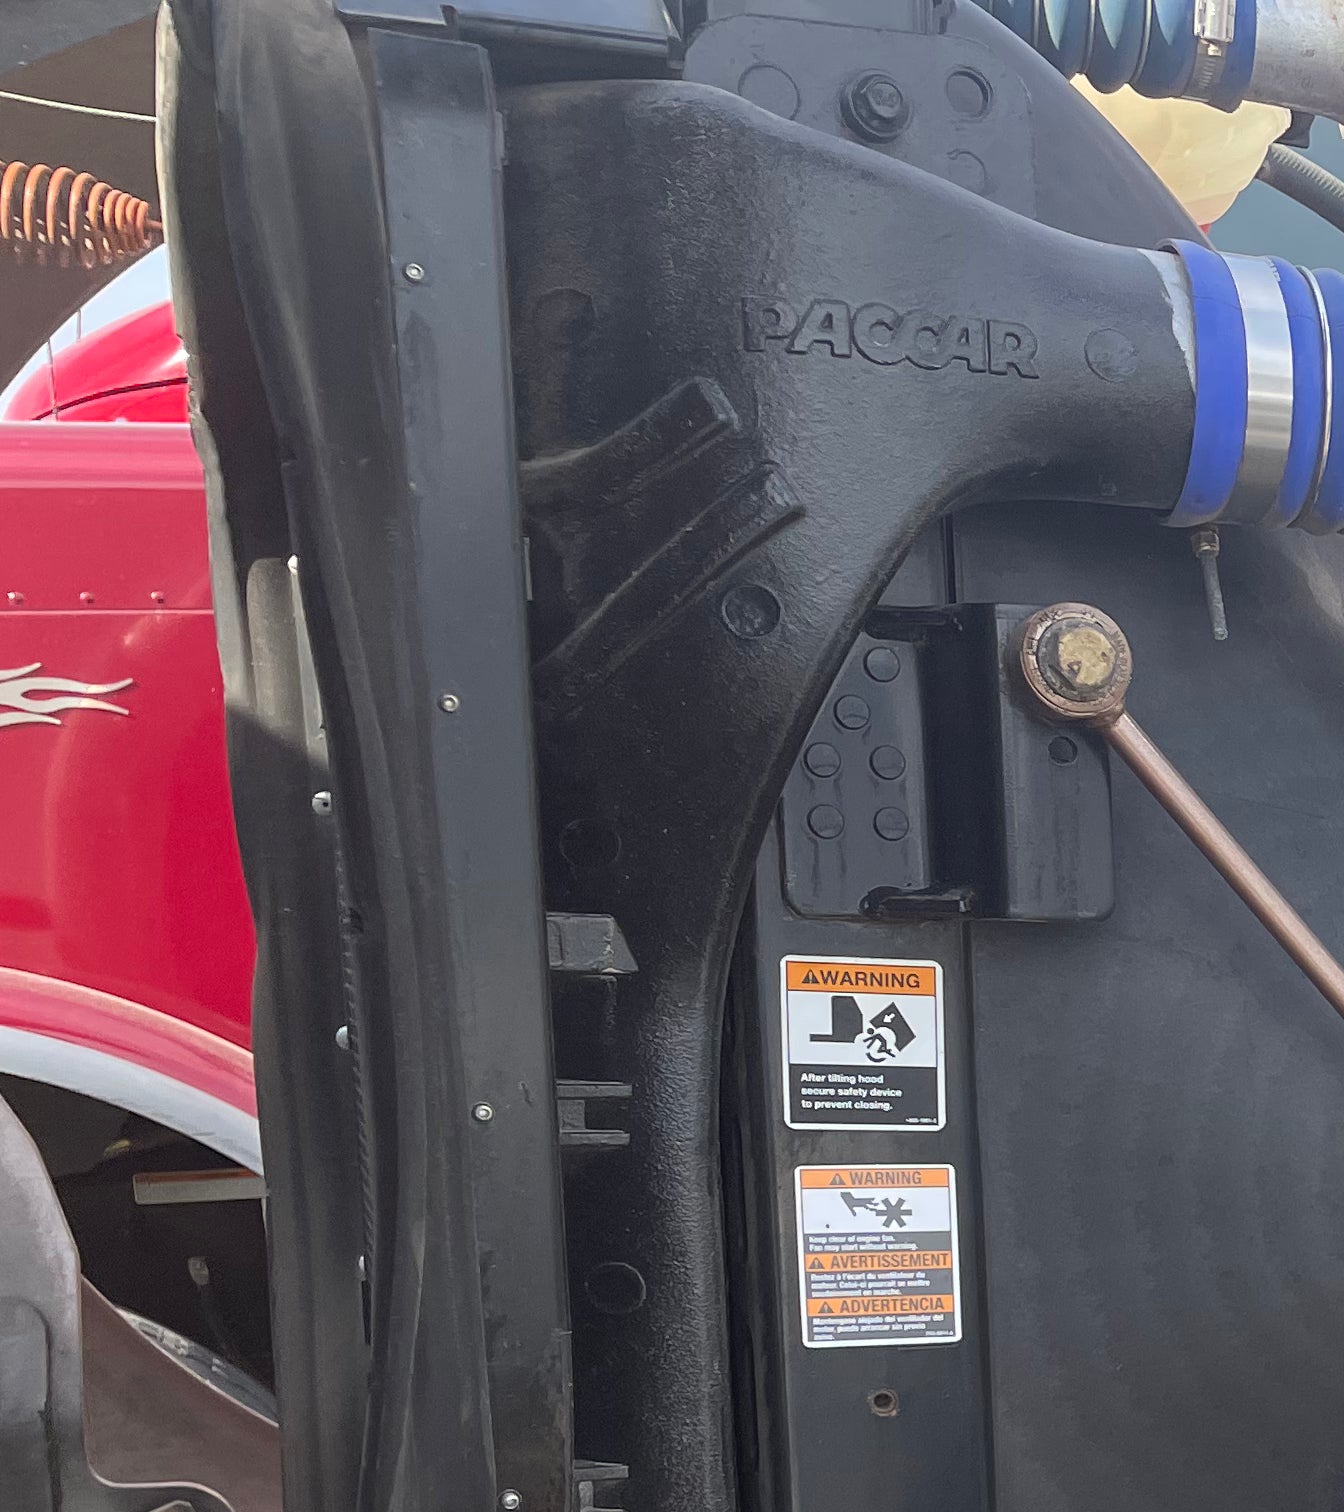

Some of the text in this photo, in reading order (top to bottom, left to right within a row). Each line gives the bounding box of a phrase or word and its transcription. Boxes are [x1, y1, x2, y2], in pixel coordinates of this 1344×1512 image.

[742, 297, 1040, 379] PACCAR
[820, 970, 920, 988] WARNING
[801, 1073, 884, 1084] After tilting hood
[801, 1087, 902, 1098] secure safety device
[801, 1100, 893, 1111] to prevent closing.
[850, 1171, 922, 1185] WARNING
[830, 1253, 949, 1269] AVERTISSEMENT
[839, 1297, 945, 1314] ADVERTENCIA
